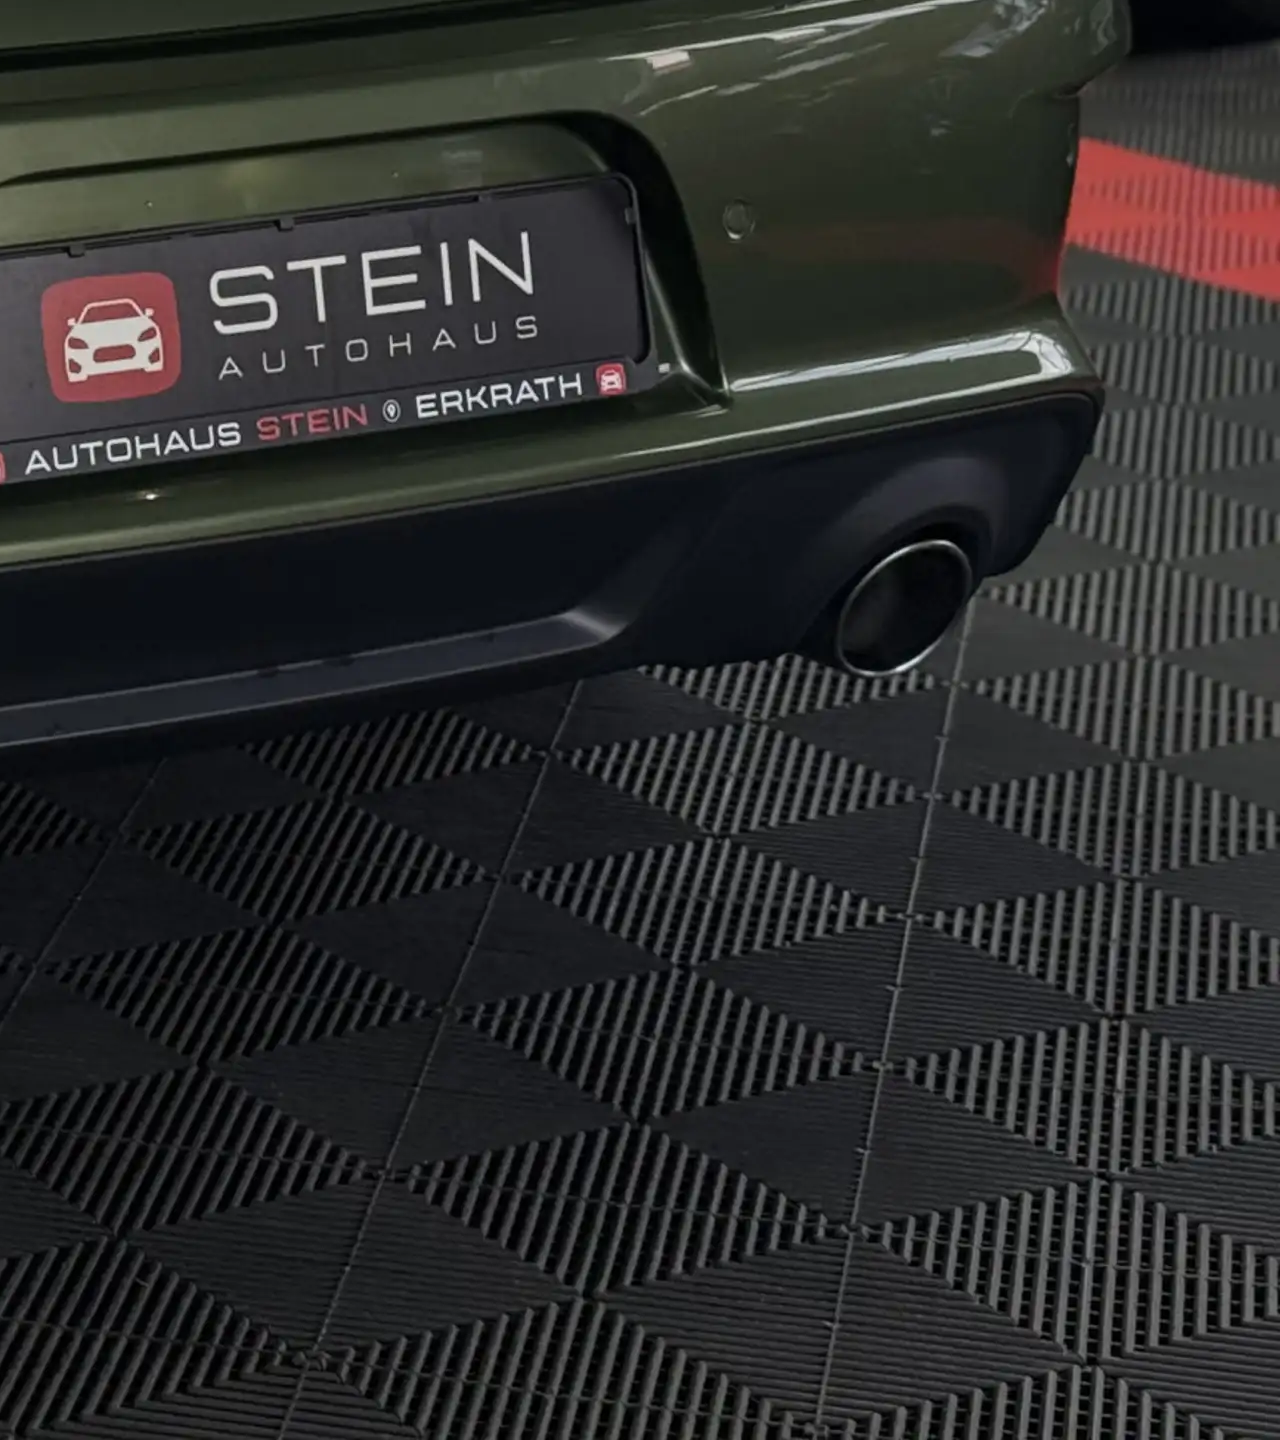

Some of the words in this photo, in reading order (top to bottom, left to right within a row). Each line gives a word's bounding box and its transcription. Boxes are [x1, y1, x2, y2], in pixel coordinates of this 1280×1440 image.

[209, 231, 534, 335] STEIN
[218, 315, 538, 380] AUTOHAUS
[24, 421, 242, 476] AUTOHAUS
[256, 404, 369, 441] STEIN
[415, 373, 584, 419] ERKRATH
